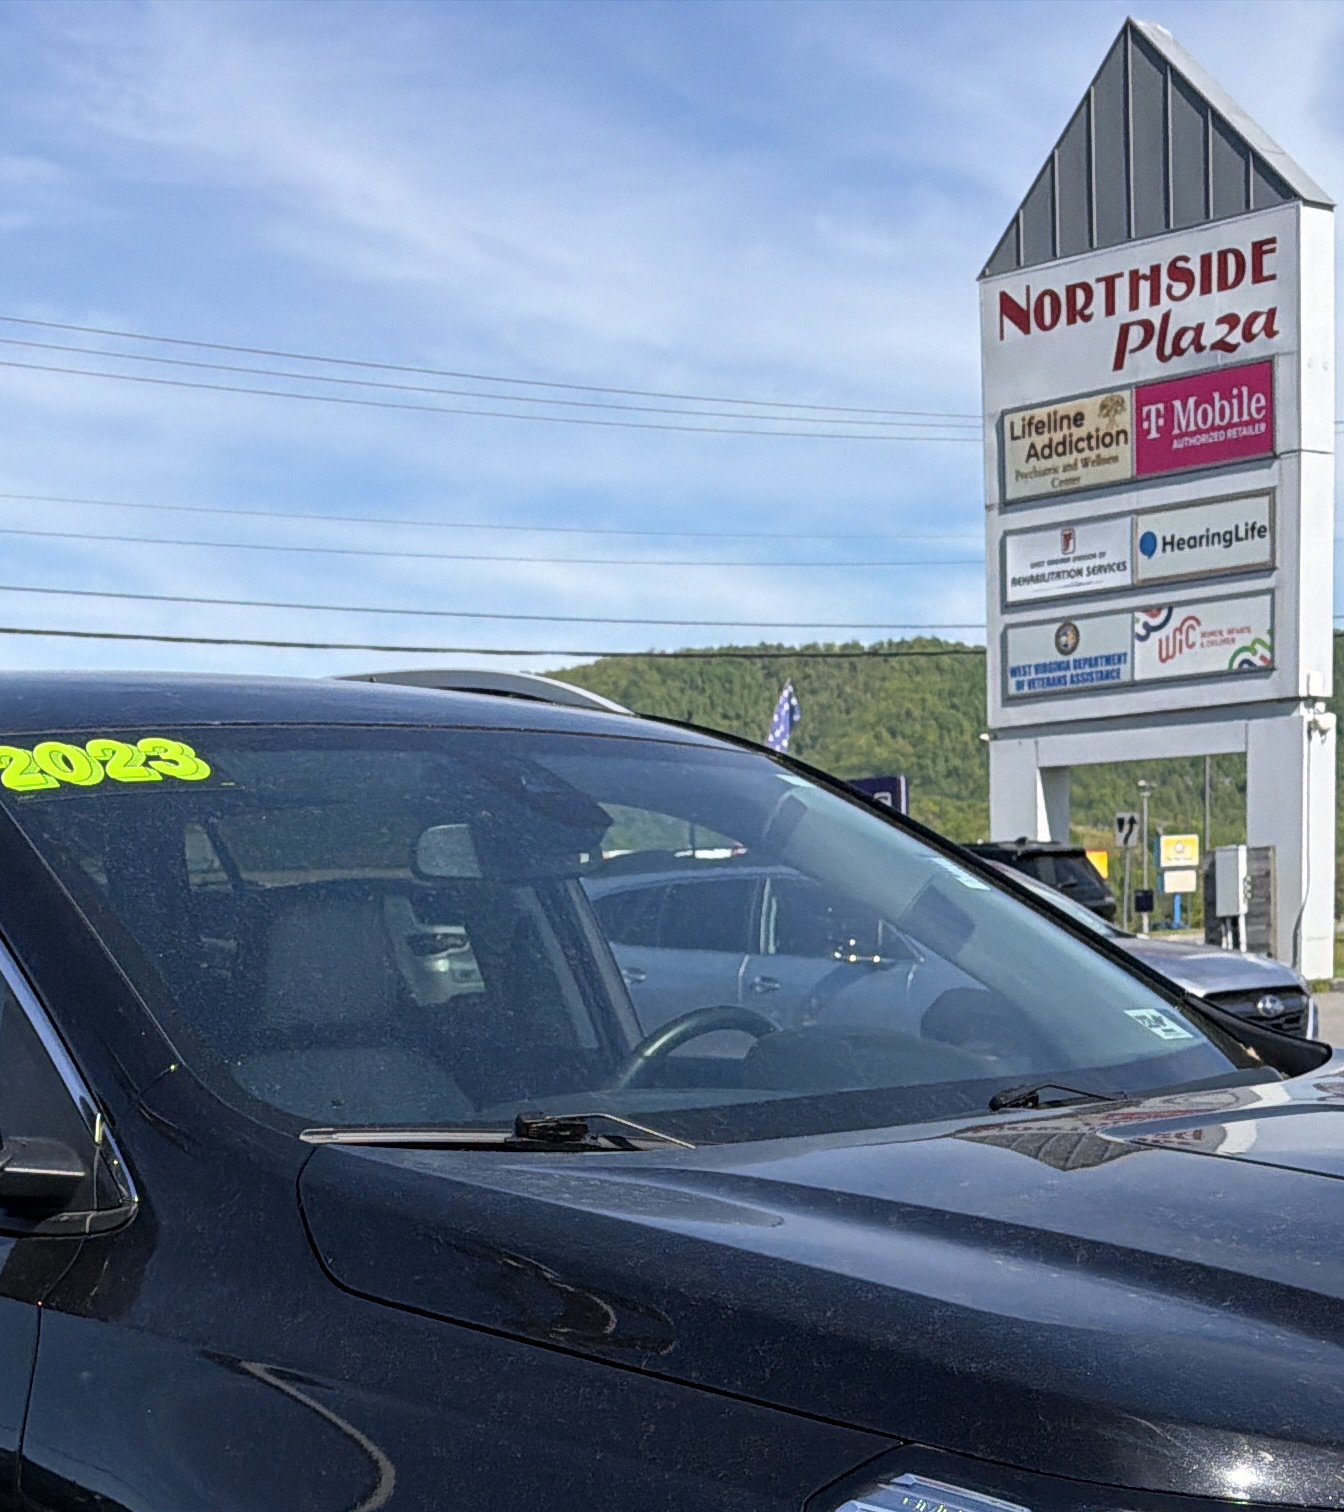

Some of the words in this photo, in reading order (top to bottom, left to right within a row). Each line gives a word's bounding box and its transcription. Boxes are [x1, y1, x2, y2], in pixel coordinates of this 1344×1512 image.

[999, 236, 1278, 341] NORTHSIDE
[1112, 306, 1280, 372] Plaza
[1009, 409, 1085, 441] Lifeline
[1171, 385, 1266, 435] Mobile
[1024, 427, 1129, 464] Addiction
[1171, 430, 1226, 450] AUTHORIZED
[1226, 422, 1267, 440] RETAILER
[1161, 521, 1268, 553] HearingLife
[1086, 560, 1128, 578] SERVICES
[1009, 664, 1032, 678] WEST
[1072, 651, 1128, 671] DEPARTMENT
